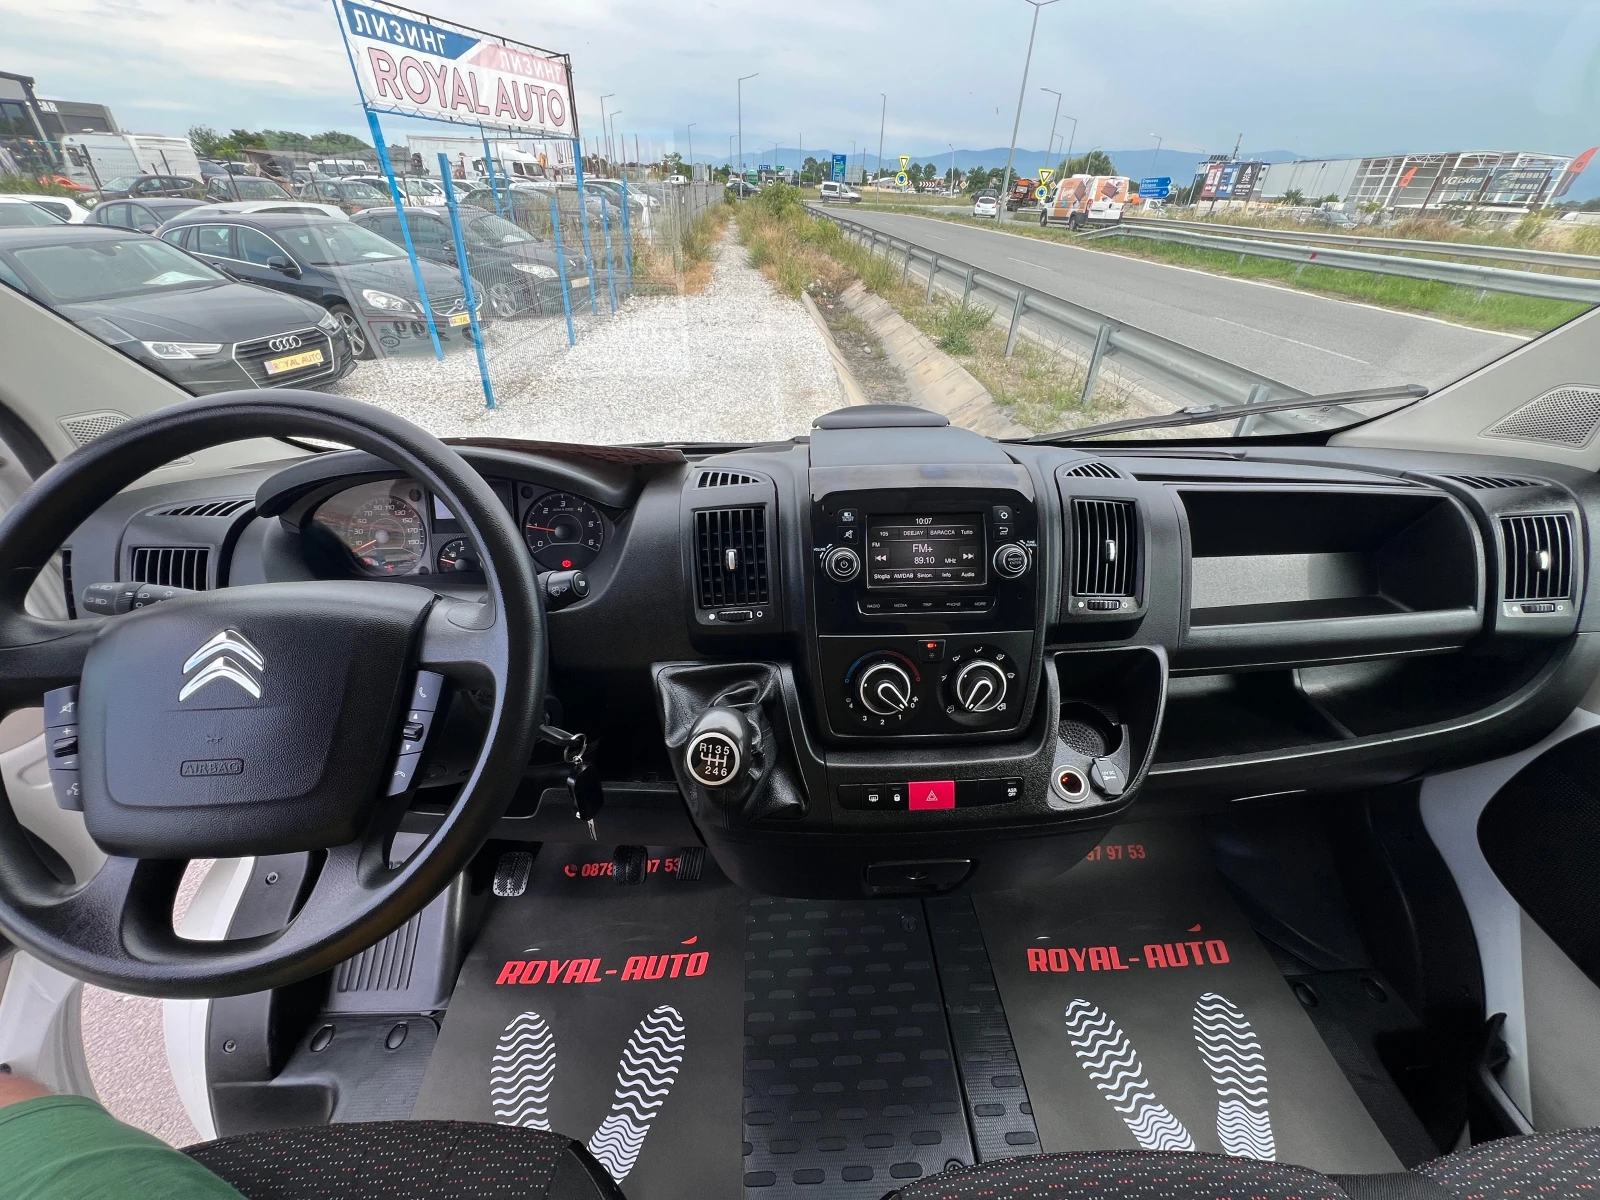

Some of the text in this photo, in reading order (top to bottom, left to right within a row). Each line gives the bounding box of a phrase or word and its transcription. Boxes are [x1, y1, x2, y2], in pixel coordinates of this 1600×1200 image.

[354, 9, 446, 53] ЛИЗИНГ
[500, 51, 562, 82] ЛИЗИНГ
[368, 47, 566, 127] ROYAL AUTO
[273, 353, 322, 370] ROYAL AUTO
[912, 543, 933, 553] FM+
[914, 556, 935, 565] 89.10
[700, 743, 730, 755] R 1 3 5
[184, 762, 241, 775] AIRBAG
[705, 766, 727, 776] 2 4 6
[1106, 845, 1122, 860] 97
[1127, 844, 1146, 859] 53
